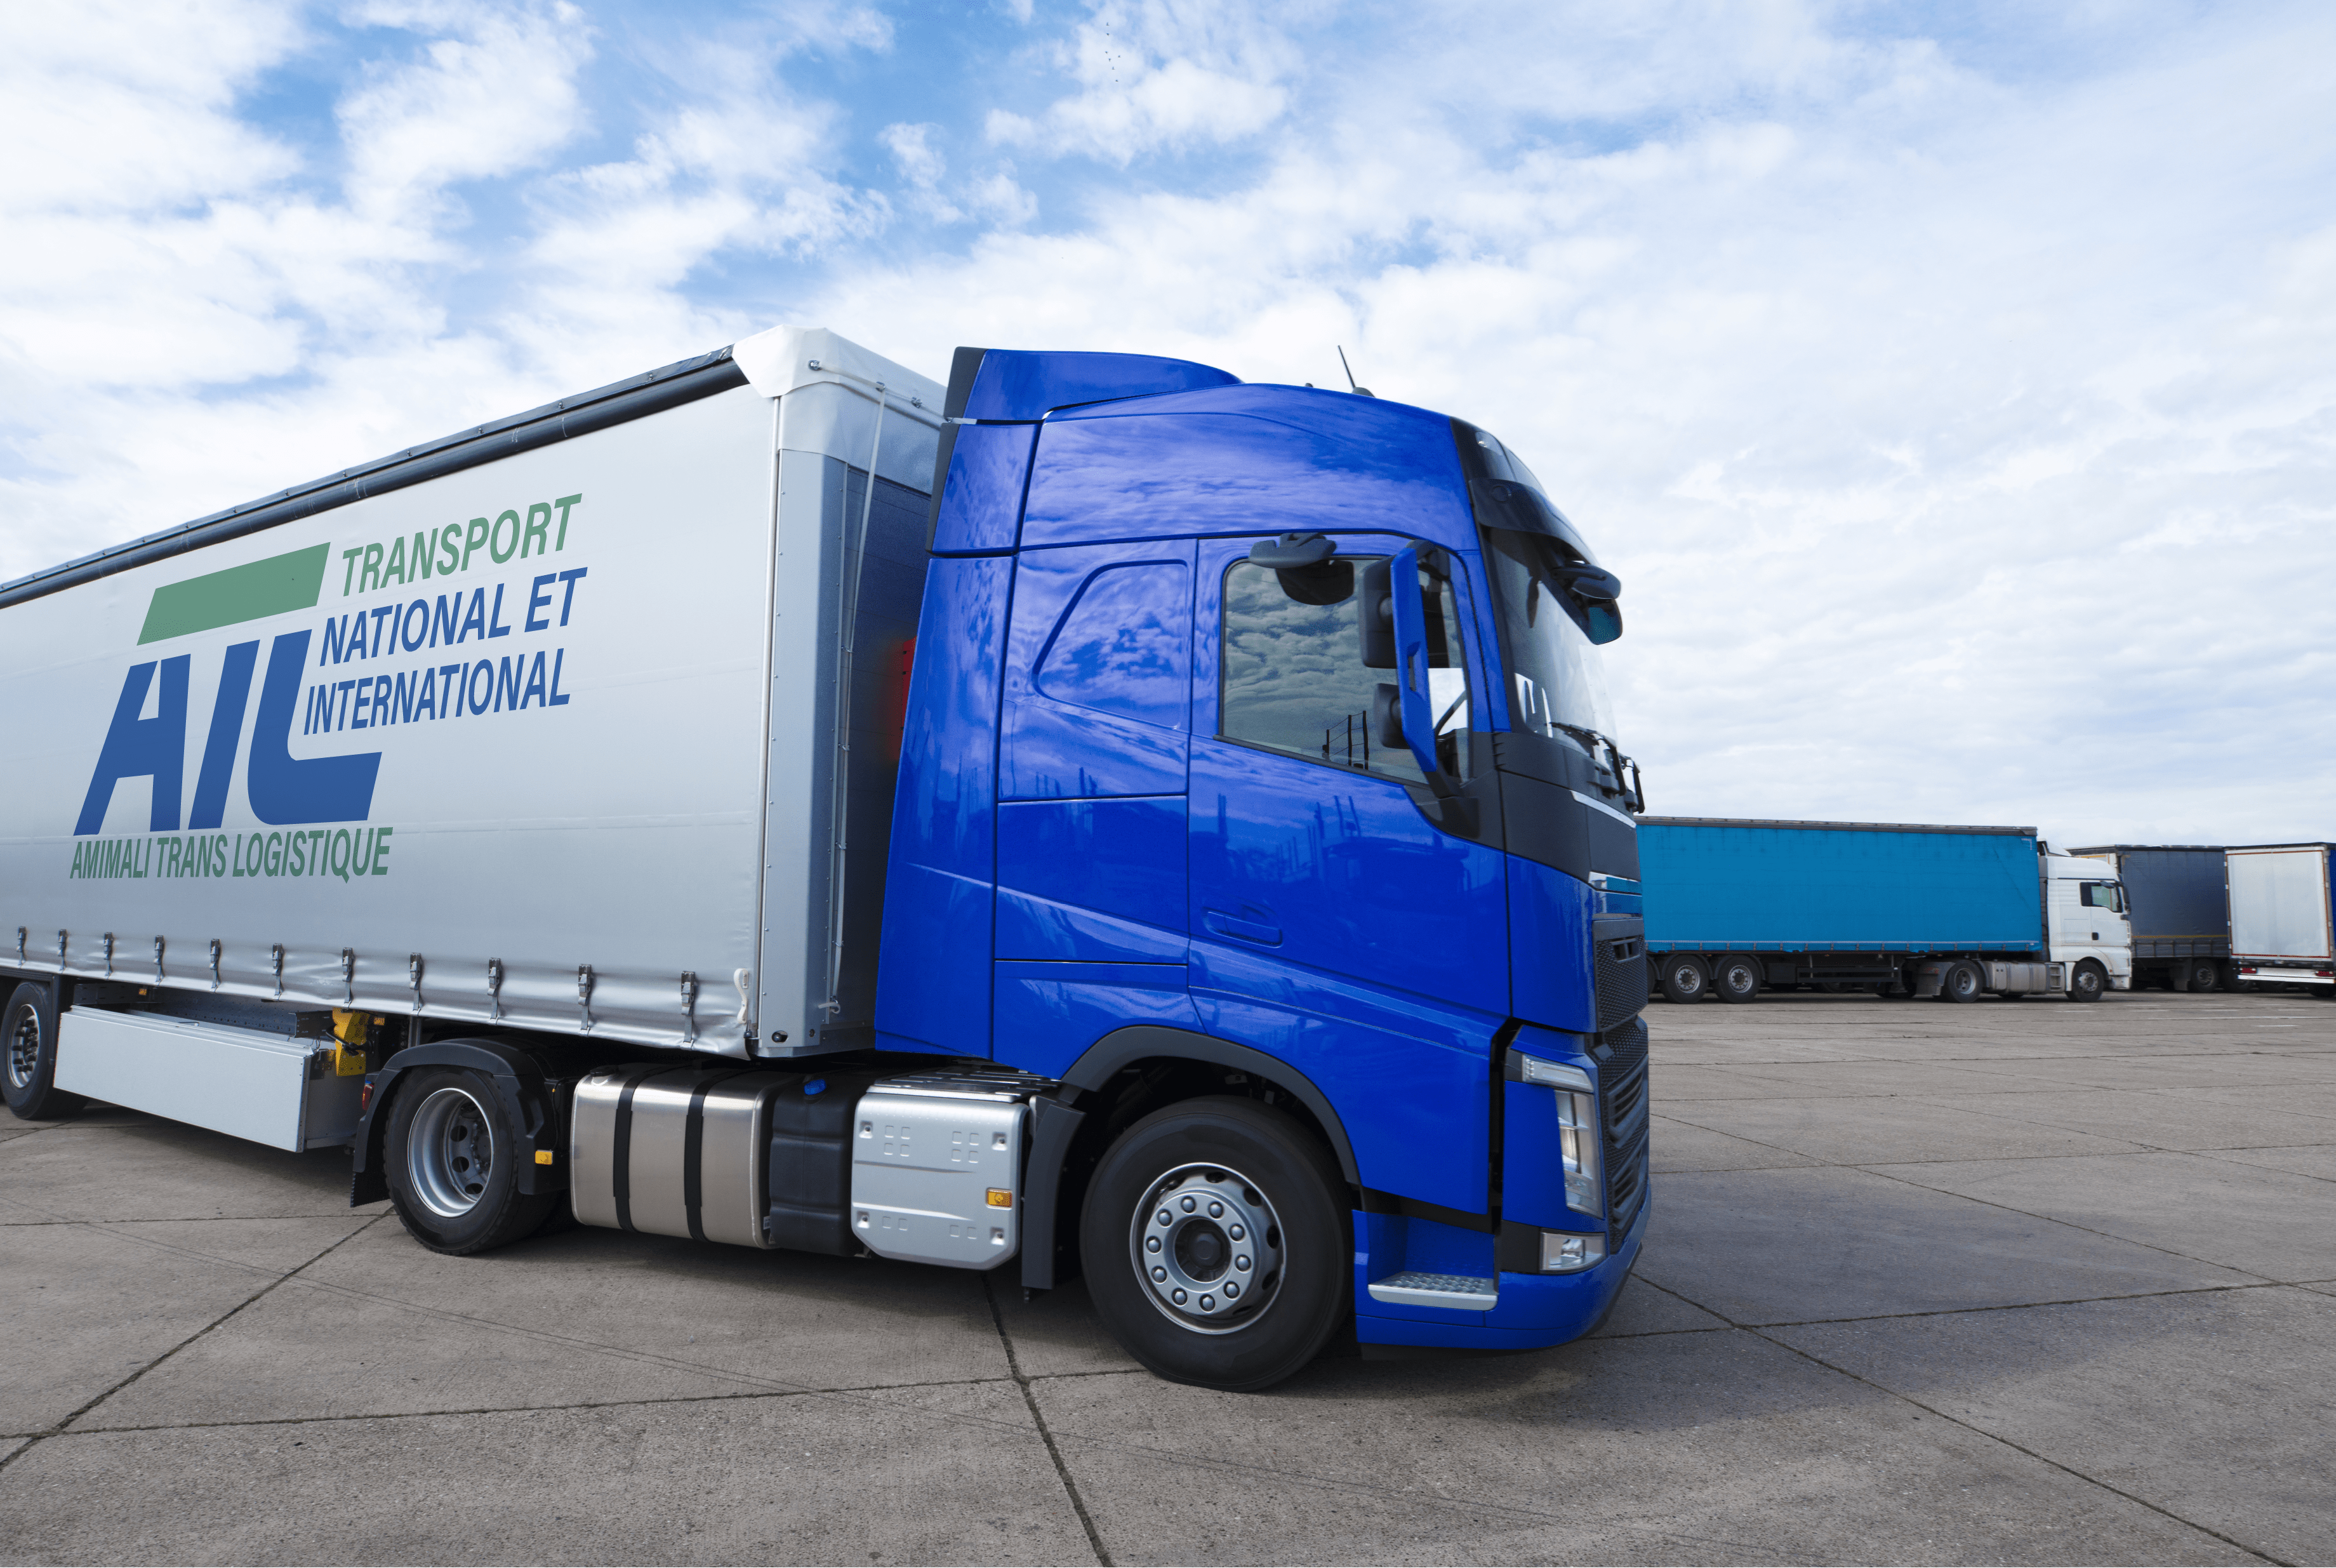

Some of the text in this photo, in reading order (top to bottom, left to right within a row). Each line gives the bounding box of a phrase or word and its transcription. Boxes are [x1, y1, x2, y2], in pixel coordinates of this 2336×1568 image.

[343, 493, 583, 597] TRANSPORT
[320, 566, 588, 667] NATIONAL ET
[303, 648, 571, 736] INTERNATIONAL
[70, 827, 394, 884] AMIMALI TRANS LOGISTIQUE
